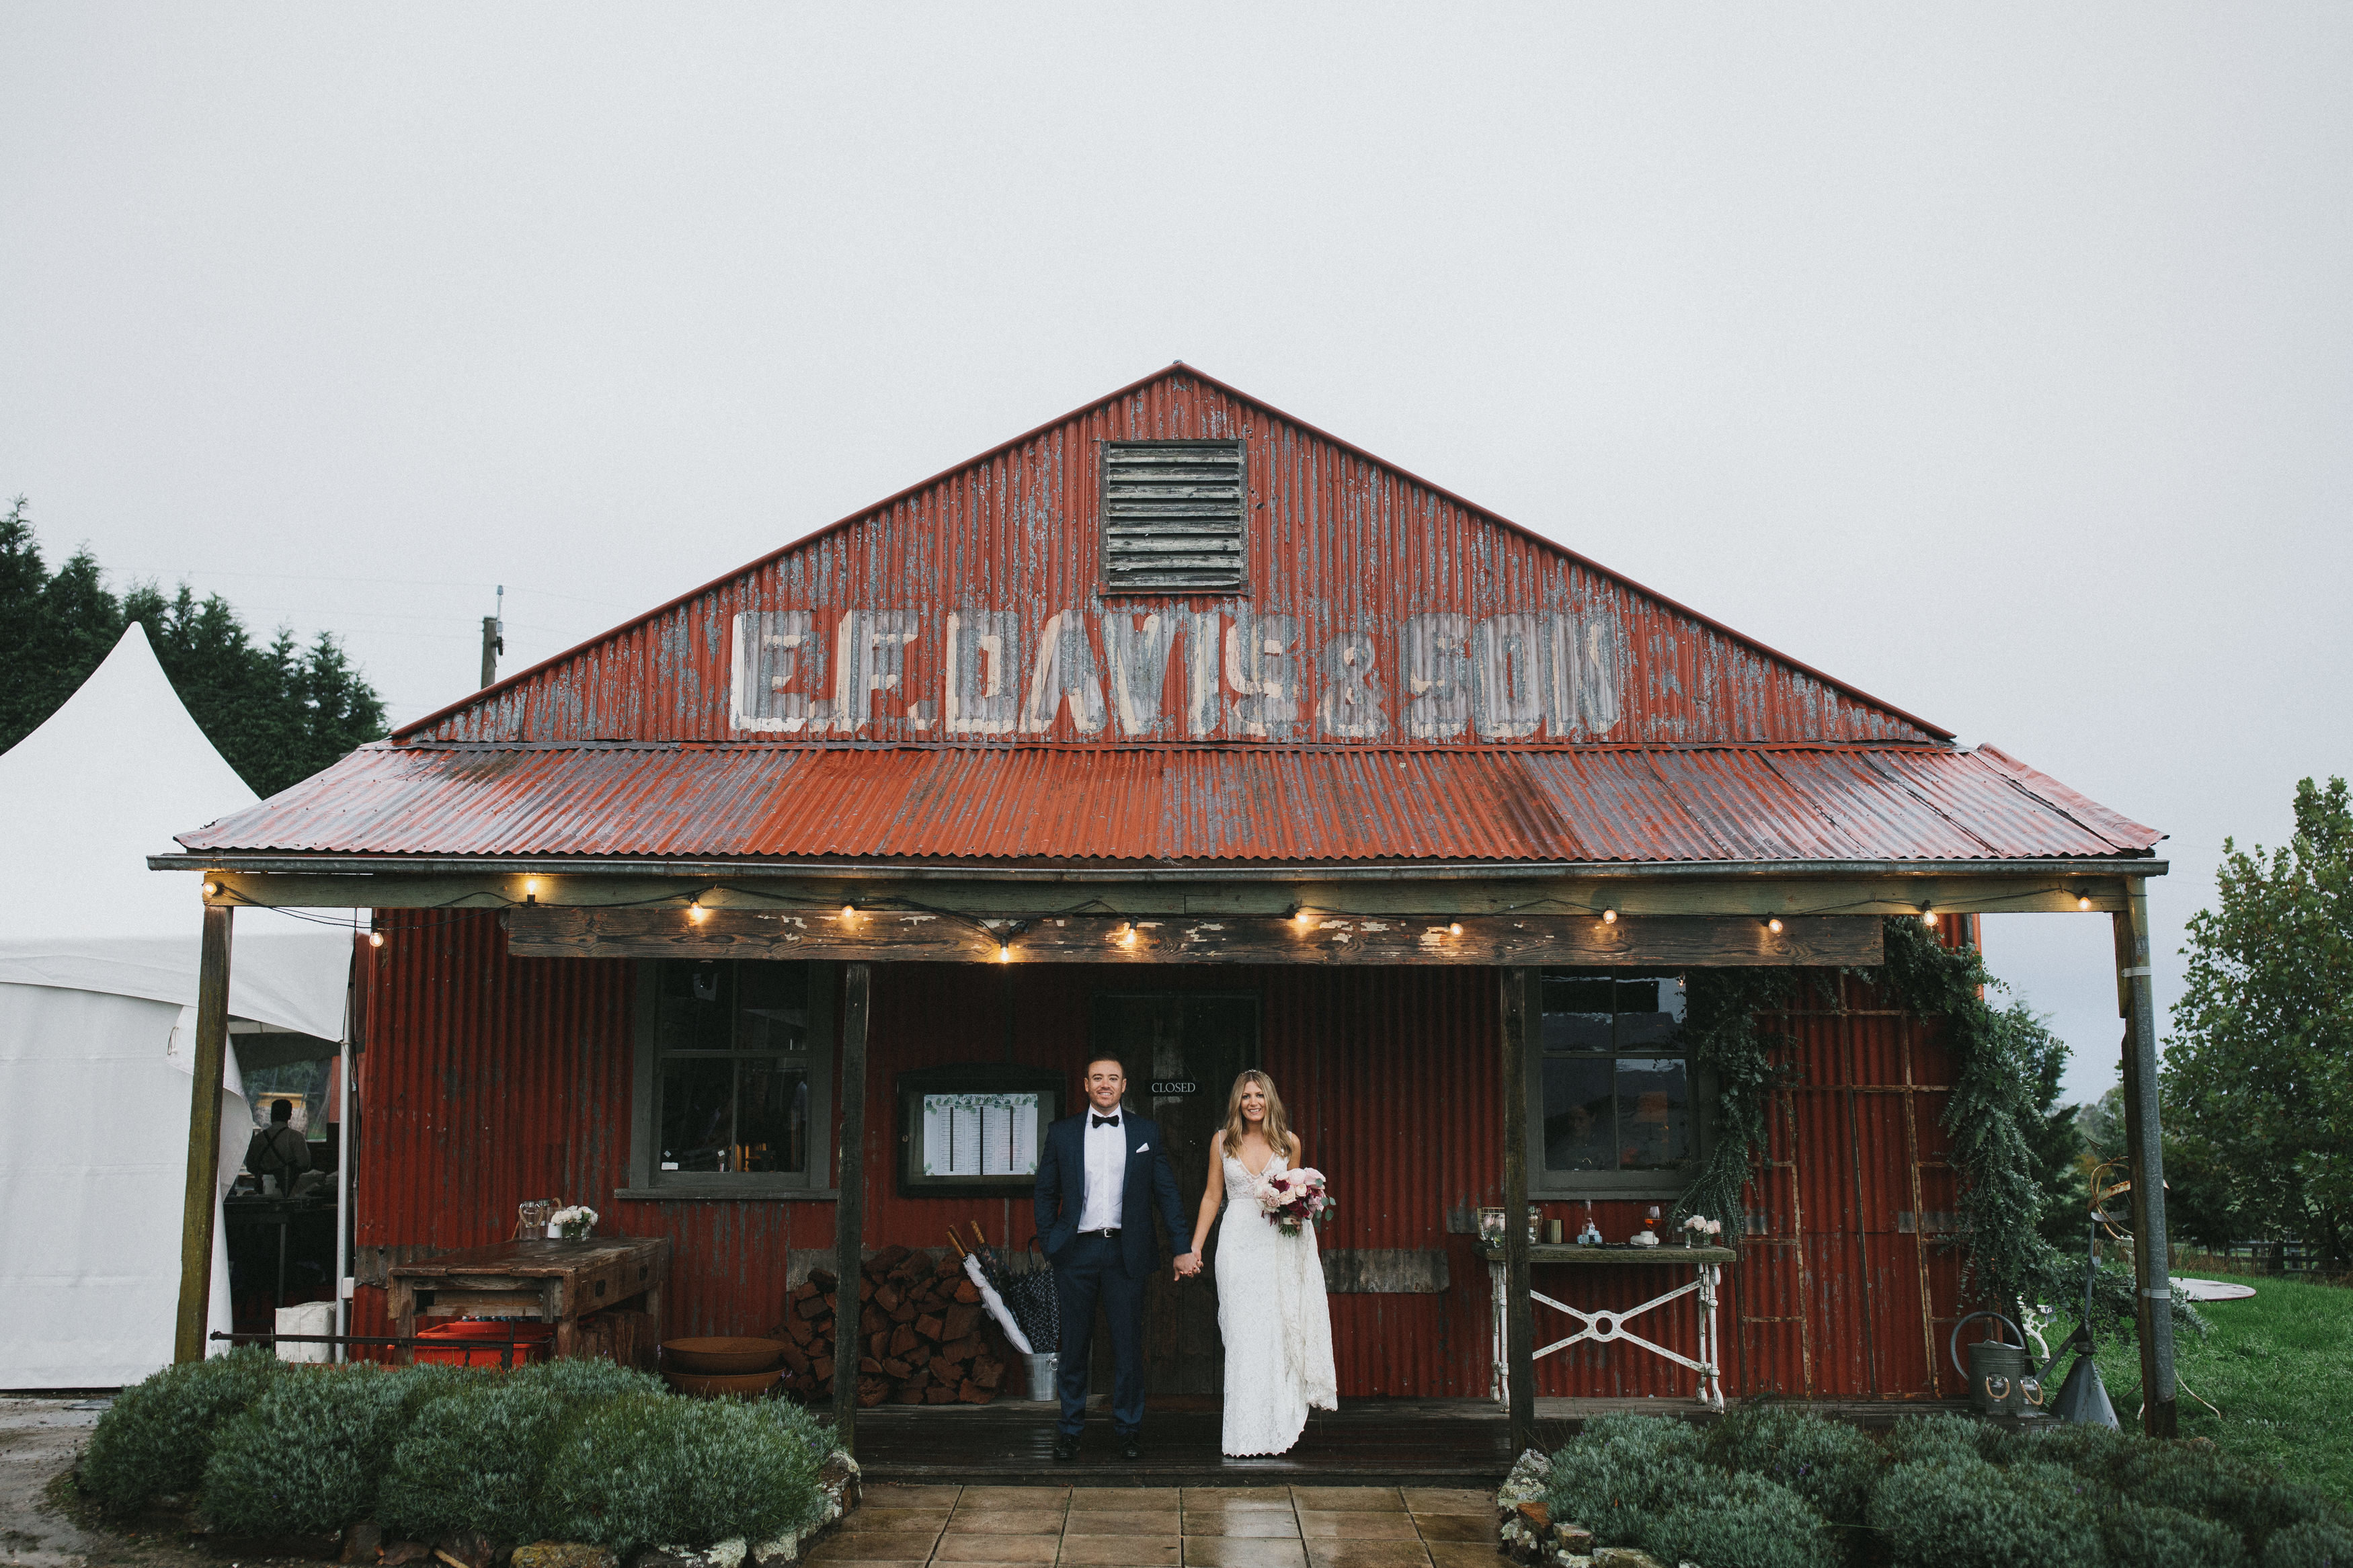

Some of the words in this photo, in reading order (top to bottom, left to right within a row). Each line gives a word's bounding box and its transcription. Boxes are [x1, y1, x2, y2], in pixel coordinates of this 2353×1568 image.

[1316, 631, 1390, 738] &
[1400, 612, 1622, 739] SON
[1151, 1082, 1196, 1093] CLOSED
